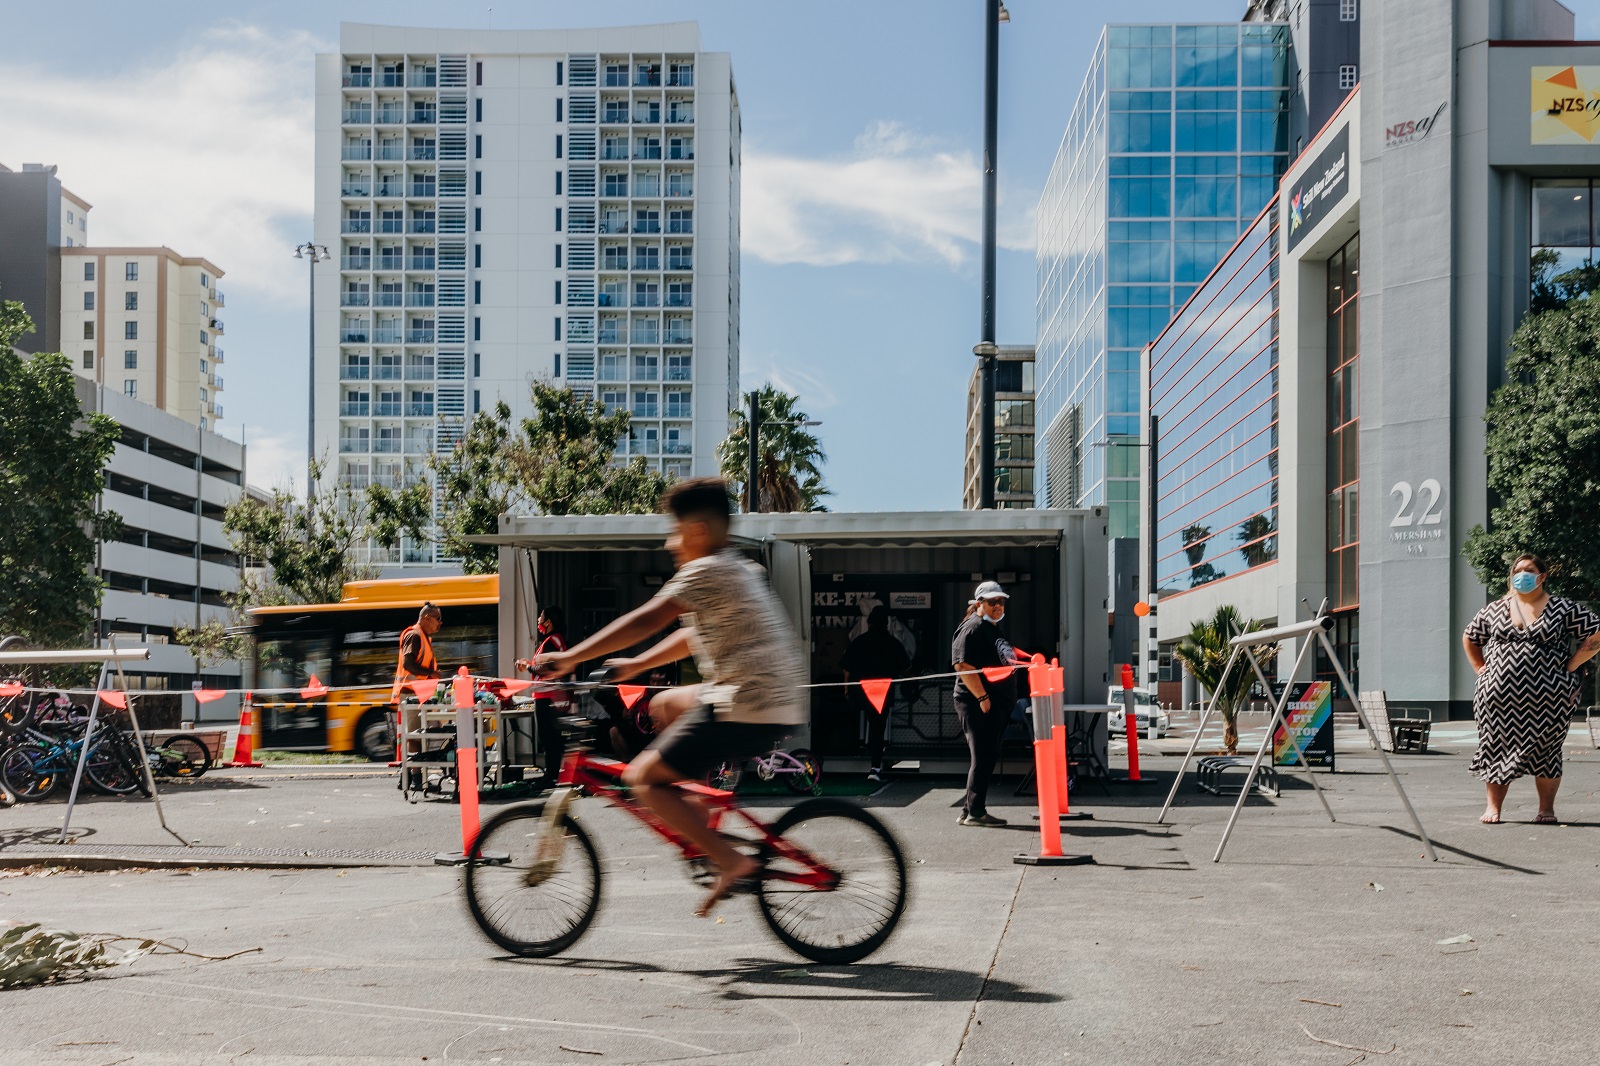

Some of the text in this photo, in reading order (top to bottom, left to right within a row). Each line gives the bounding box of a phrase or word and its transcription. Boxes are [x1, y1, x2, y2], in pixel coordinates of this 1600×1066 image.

[1389, 478, 1442, 527] 22
[1389, 529, 1442, 541] AMERSHAM
[1287, 701, 1316, 710] BIKE
[1292, 714, 1313, 722] PIT
